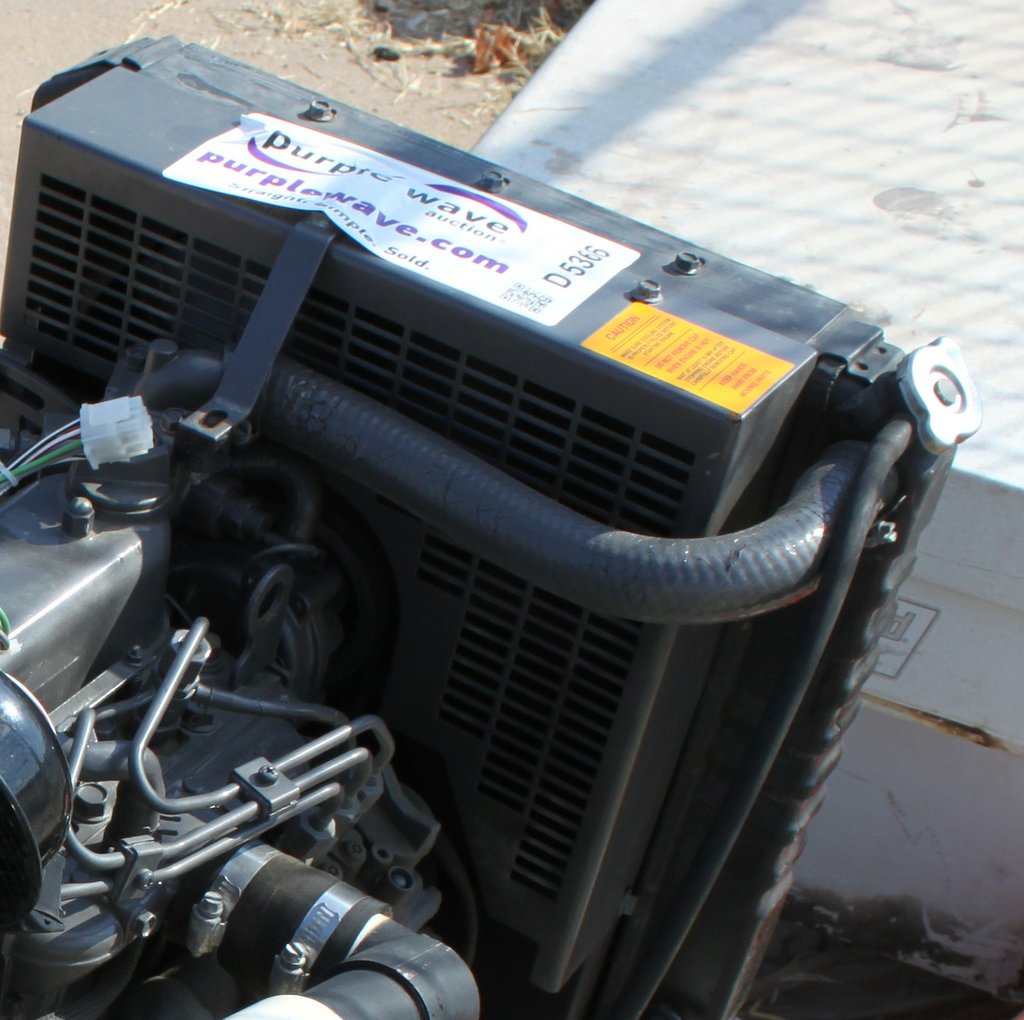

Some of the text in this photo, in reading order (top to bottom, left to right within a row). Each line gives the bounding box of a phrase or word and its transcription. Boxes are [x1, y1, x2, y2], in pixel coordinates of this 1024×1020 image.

[196, 151, 510, 274] purplewave.com
[406, 188, 509, 234] wave
[425, 210, 496, 242] auction
[384, 246, 431, 270] Sold.
[606, 314, 640, 340] CAUTION
